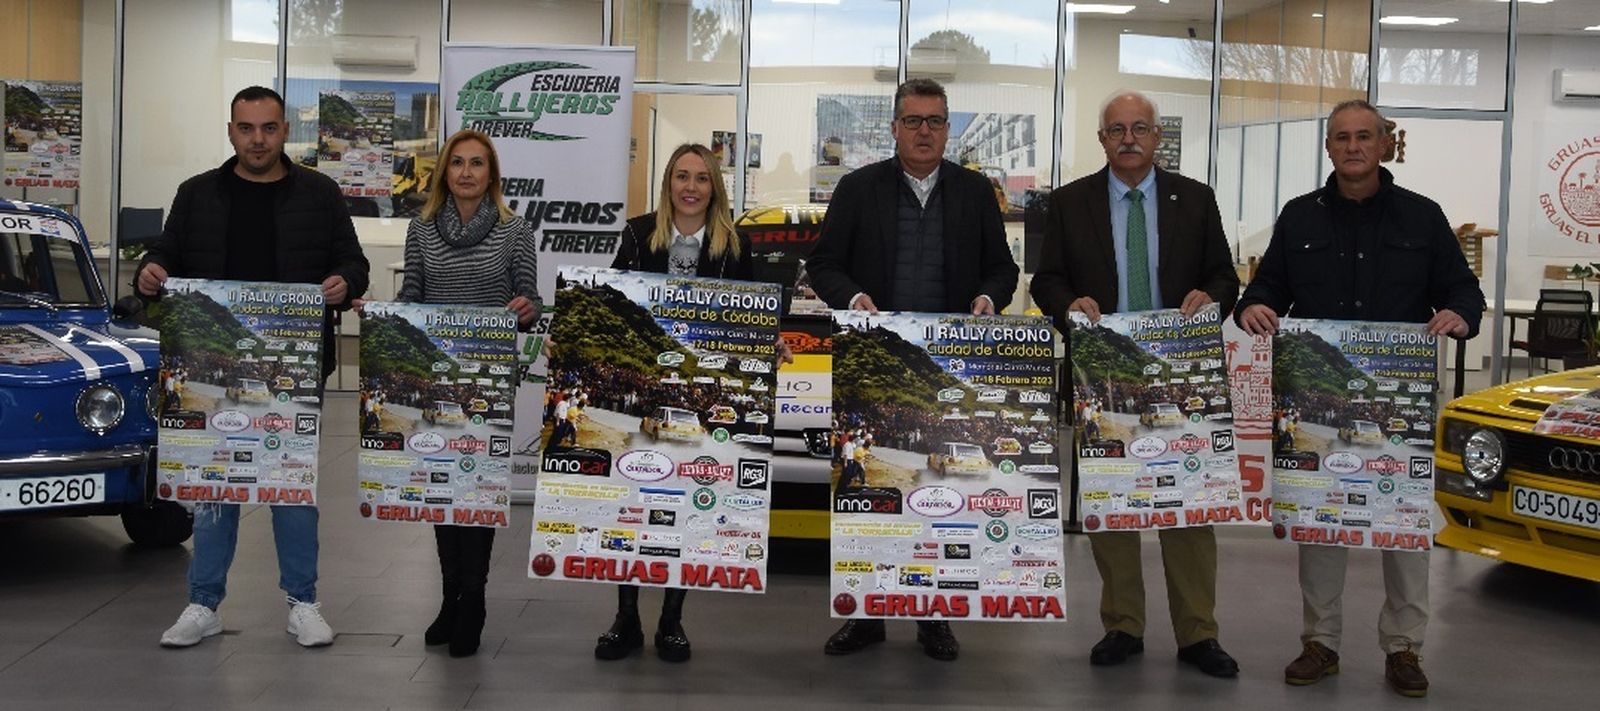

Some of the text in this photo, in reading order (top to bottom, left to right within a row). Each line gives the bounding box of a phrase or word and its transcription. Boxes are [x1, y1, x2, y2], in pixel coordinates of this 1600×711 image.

[531, 74, 620, 93] ESCUDERIA
[461, 115, 535, 138] FOREVER
[540, 229, 619, 254] FOREVER
[228, 291, 323, 305] II RALLY CRONO
[648, 286, 659, 301] II
[664, 287, 714, 304] RALLY
[718, 292, 777, 310] CRONO
[425, 314, 432, 326] II
[435, 314, 469, 327] RALLY
[473, 316, 515, 328] CRONO
[651, 304, 777, 326] Ciudad de Córdoba
[1139, 317, 1175, 330] RALLY
[1177, 312, 1219, 327] CRONO
[923, 326, 1051, 342] II RALLY CRONO
[1350, 331, 1386, 343] RALLY
[1390, 332, 1435, 345] CRONO
[692, 340, 775, 354] 17-18 Febrero 2023
[927, 342, 1052, 357] Ciudad de Córdoba
[972, 375, 1052, 385] 17-18 Febrero 2023
[743, 467, 763, 480] RG3
[176, 485, 314, 504] GRUAS MATA
[376, 505, 507, 526] GRUAS MATA
[1105, 505, 1242, 529] GRUAS MATA
[1291, 526, 1430, 550] GRUAS MATA
[563, 556, 763, 591] GRUAS MATA
[864, 594, 1065, 619] GRUAS MATA
